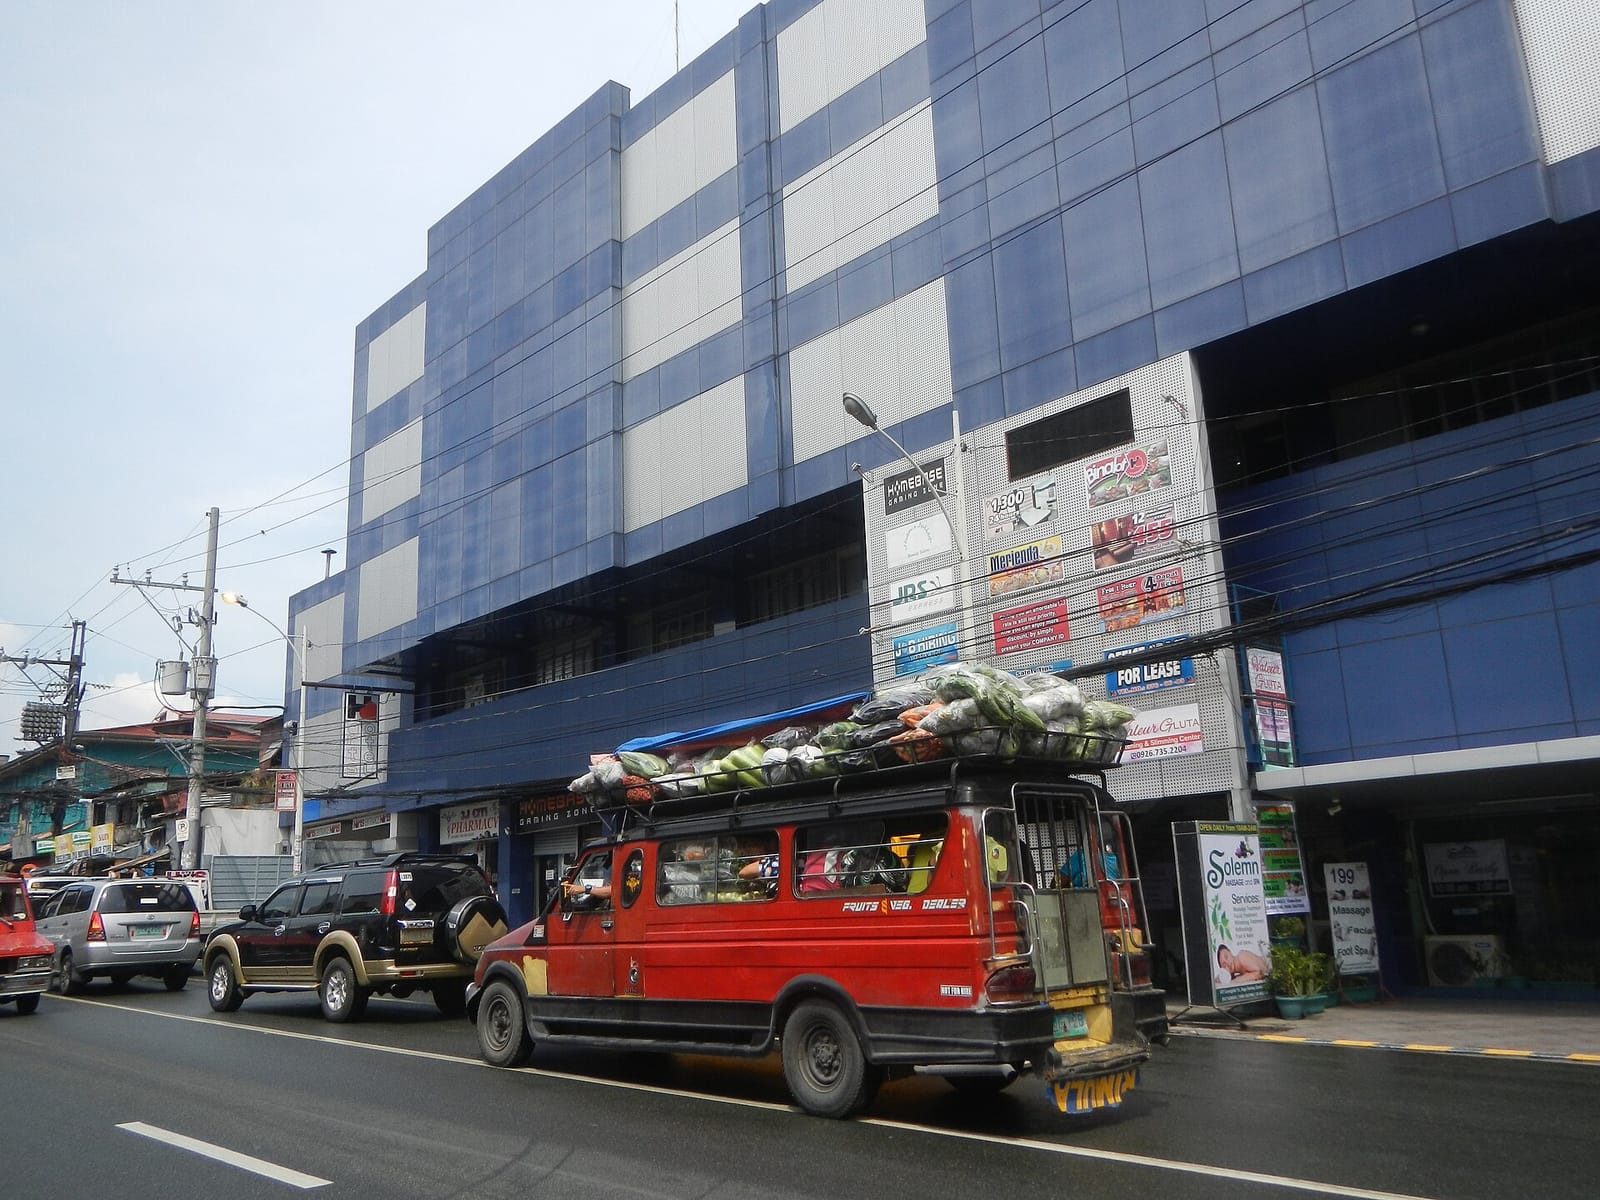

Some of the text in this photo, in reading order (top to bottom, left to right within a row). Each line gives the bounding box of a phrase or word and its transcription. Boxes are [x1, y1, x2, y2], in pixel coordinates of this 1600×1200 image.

[991, 490, 1025, 513] 1,300
[1132, 512, 1145, 525] 12
[1131, 517, 1173, 545] 455
[990, 546, 1039, 572] Merienda
[893, 580, 928, 606] JRS
[1032, 635, 1057, 645] COMPANY
[1117, 667, 1140, 686] FOR
[1144, 660, 1181, 681] LEASE
[1126, 720, 1159, 737] aleur
[1150, 737, 1178, 747] Slimming
[1179, 734, 1200, 742] Center
[1136, 746, 1187, 758] 0926.735.2204
[520, 792, 586, 815] HOMEBAS
[451, 816, 498, 833] PHARMACY
[520, 813, 558, 826] GAMING
[1207, 850, 1259, 889] Solemn
[1330, 868, 1355, 884] 199
[1225, 879, 1244, 887] MASSAGE
[842, 901, 879, 912] FRUITS
[889, 900, 912, 910] VEG.
[922, 899, 966, 910] DEALER
[1332, 906, 1370, 916] Massage
[1354, 945, 1369, 956] Spa
